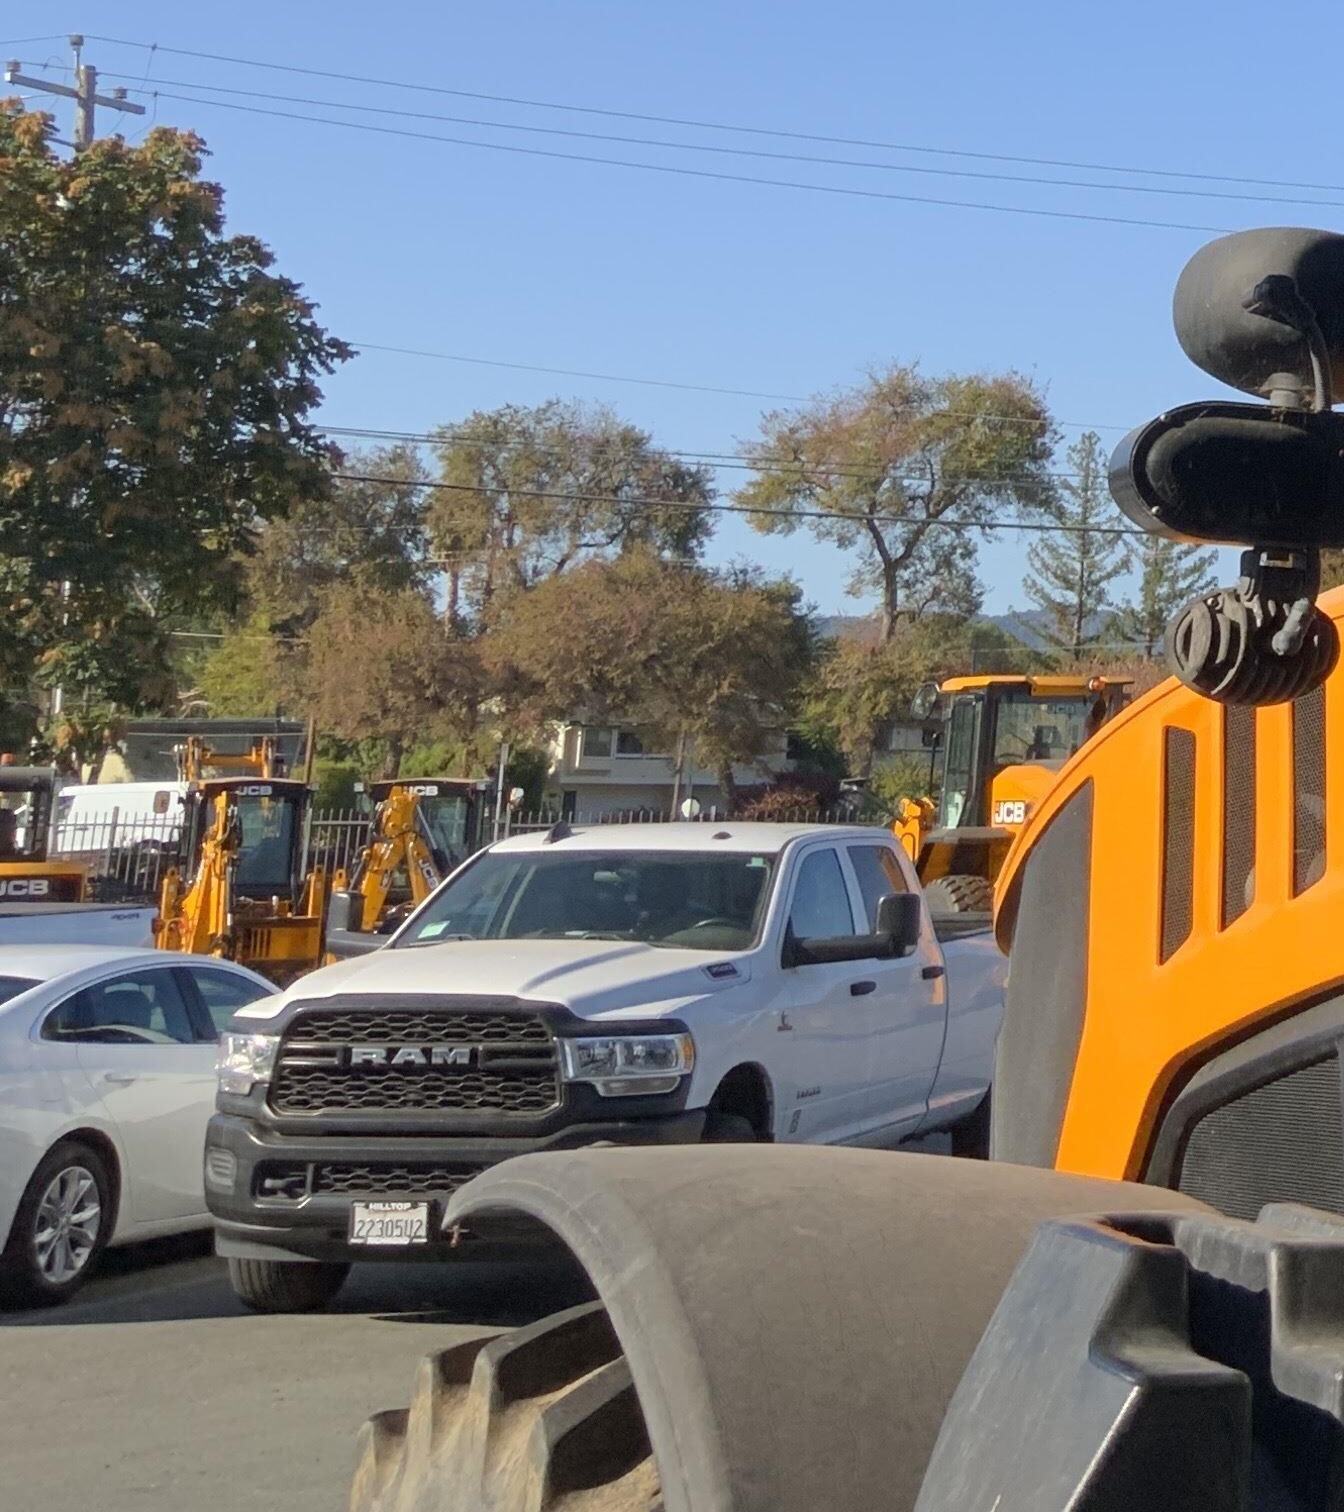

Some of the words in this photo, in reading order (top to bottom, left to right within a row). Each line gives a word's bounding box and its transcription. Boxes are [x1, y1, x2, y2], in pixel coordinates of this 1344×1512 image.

[235, 786, 272, 795] JCB
[994, 801, 1025, 824] JCB
[418, 858, 440, 889] JCB
[350, 1048, 470, 1065] RAM
[368, 1202, 412, 1210] HILLTOP
[356, 1219, 424, 1239] 22305U2
